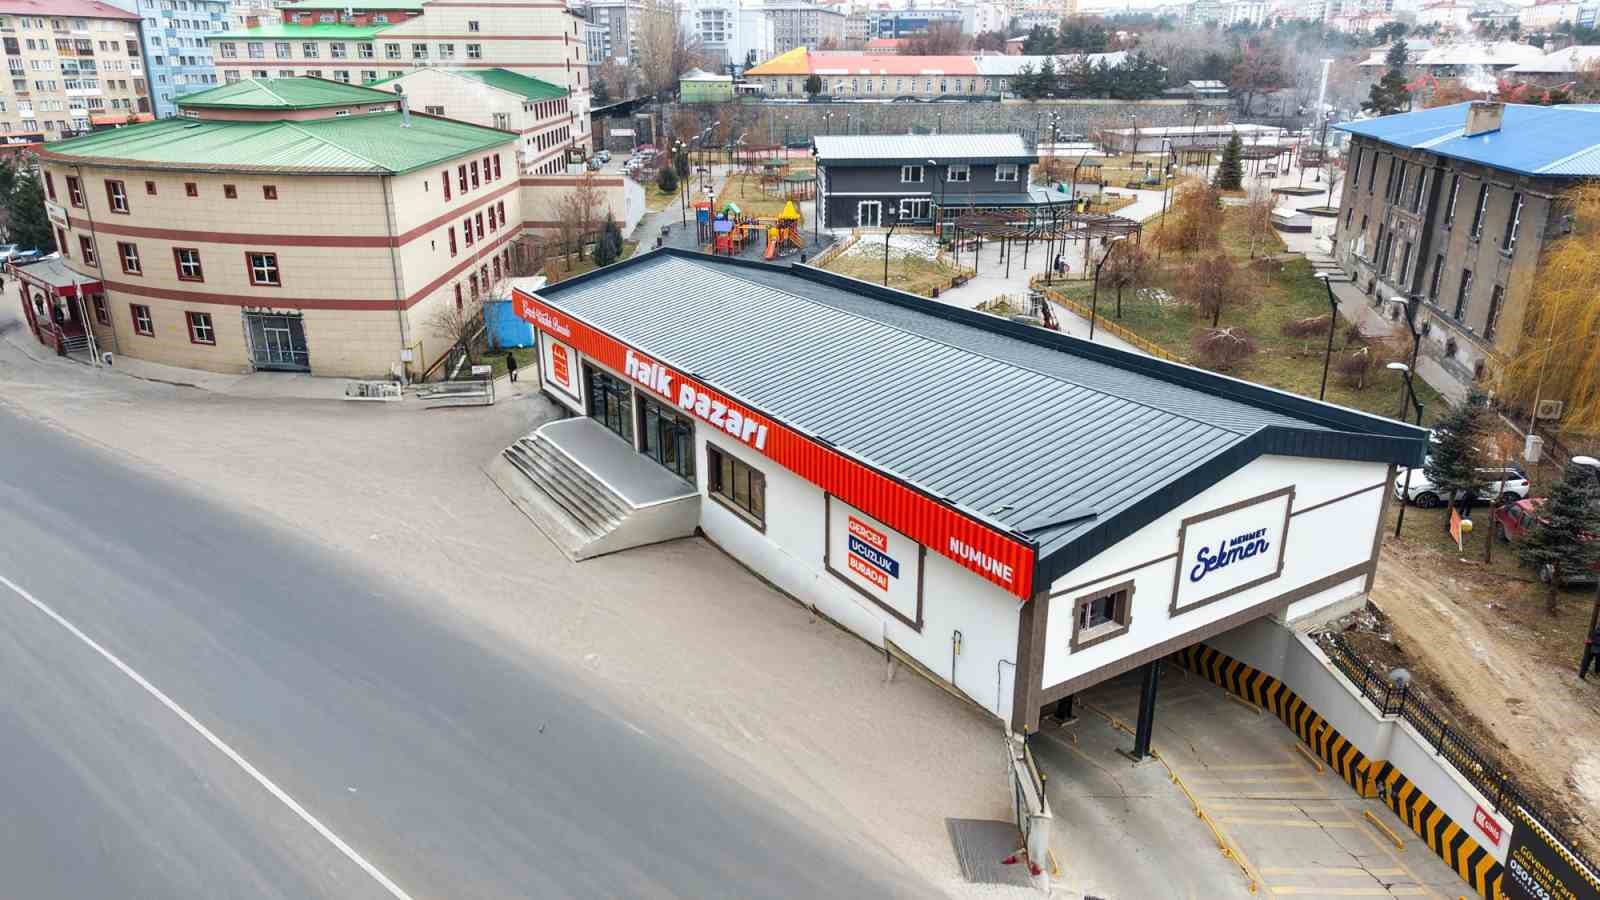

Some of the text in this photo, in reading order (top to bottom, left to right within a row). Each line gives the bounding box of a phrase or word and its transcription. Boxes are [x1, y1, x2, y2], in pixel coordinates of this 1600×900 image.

[625, 350, 768, 450] halk pazarı
[852, 539, 892, 571] UCUZLUK
[1230, 528, 1267, 547] MEHMET
[950, 536, 1014, 584] NUMUNE
[1190, 539, 1270, 582] Sekmen
